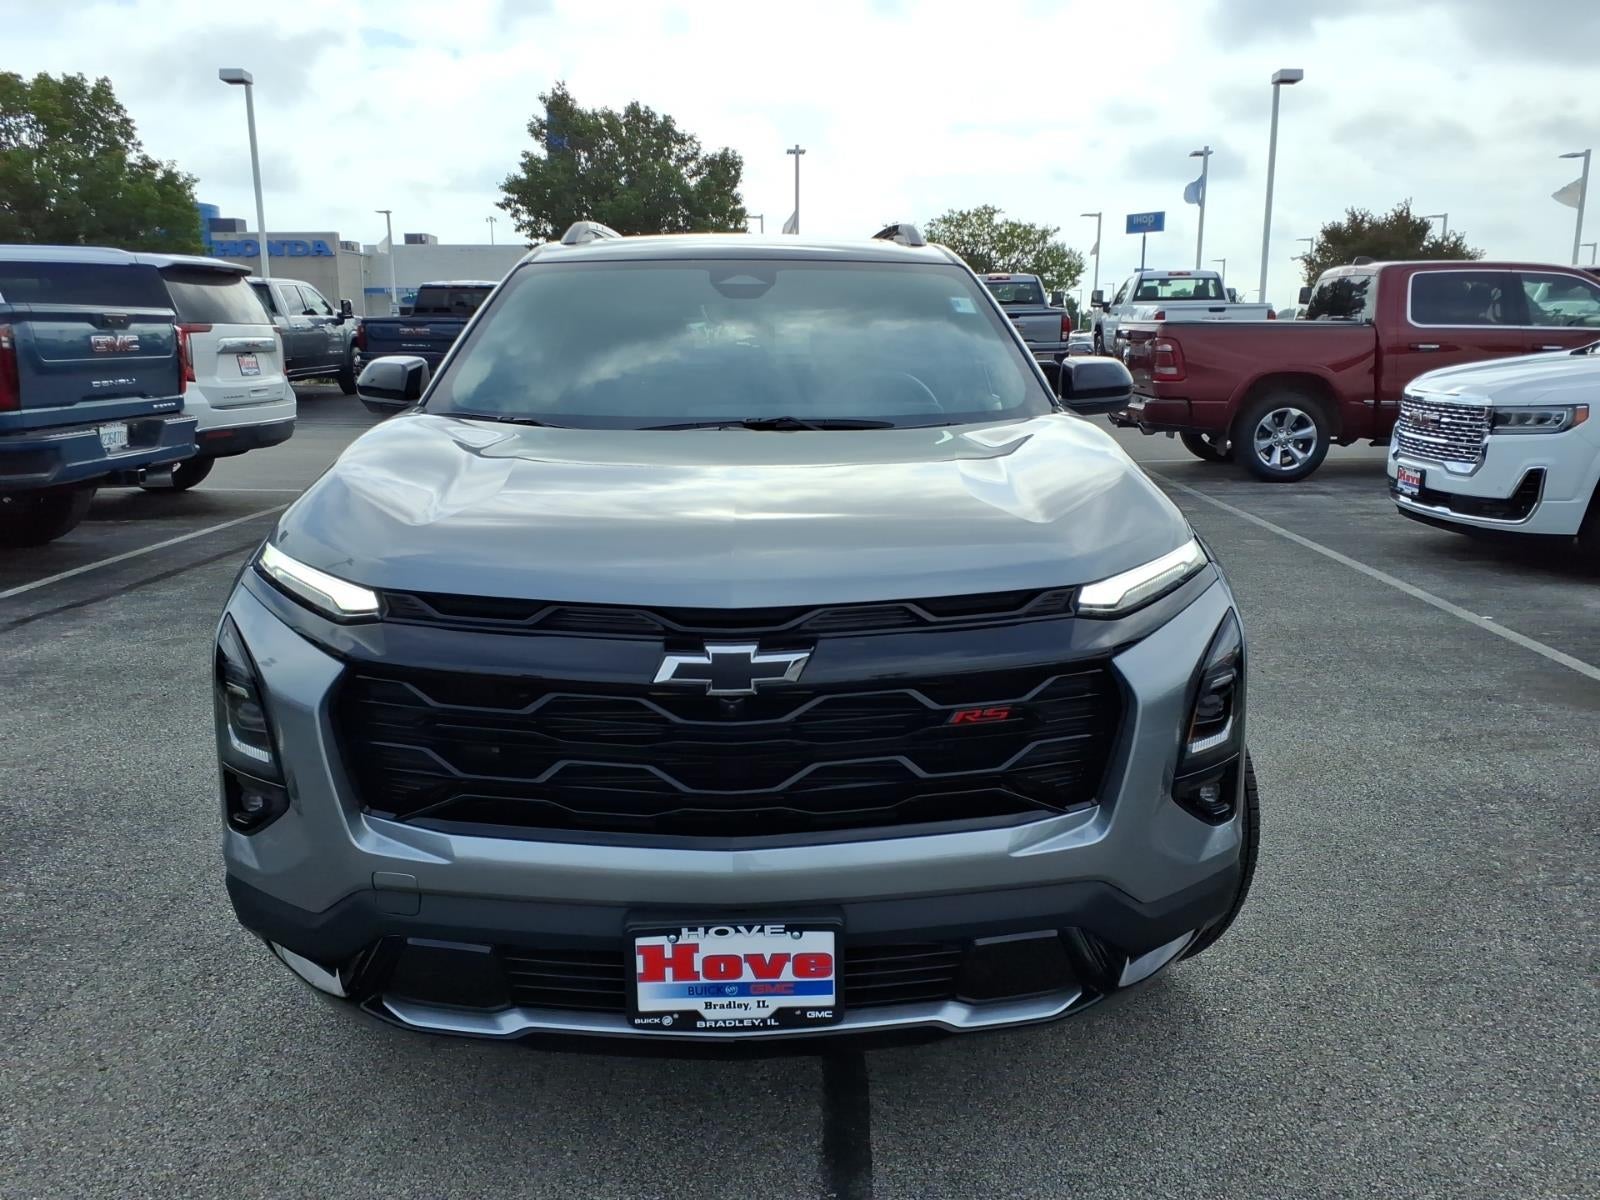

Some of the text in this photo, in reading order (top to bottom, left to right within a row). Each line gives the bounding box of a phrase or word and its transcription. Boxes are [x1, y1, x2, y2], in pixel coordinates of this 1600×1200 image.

[212, 239, 336, 257] HONDA
[91, 335, 140, 352] GMC
[949, 705, 1011, 724] RS
[681, 924, 787, 941] HOVE
[636, 943, 833, 983] Hove
[688, 985, 724, 996] BUICK
[751, 983, 795, 995] GMC
[704, 1000, 770, 1012] Bradley, IL
[806, 1011, 833, 1019] GMC
[696, 1018, 780, 1028] BRADLEY, IL
